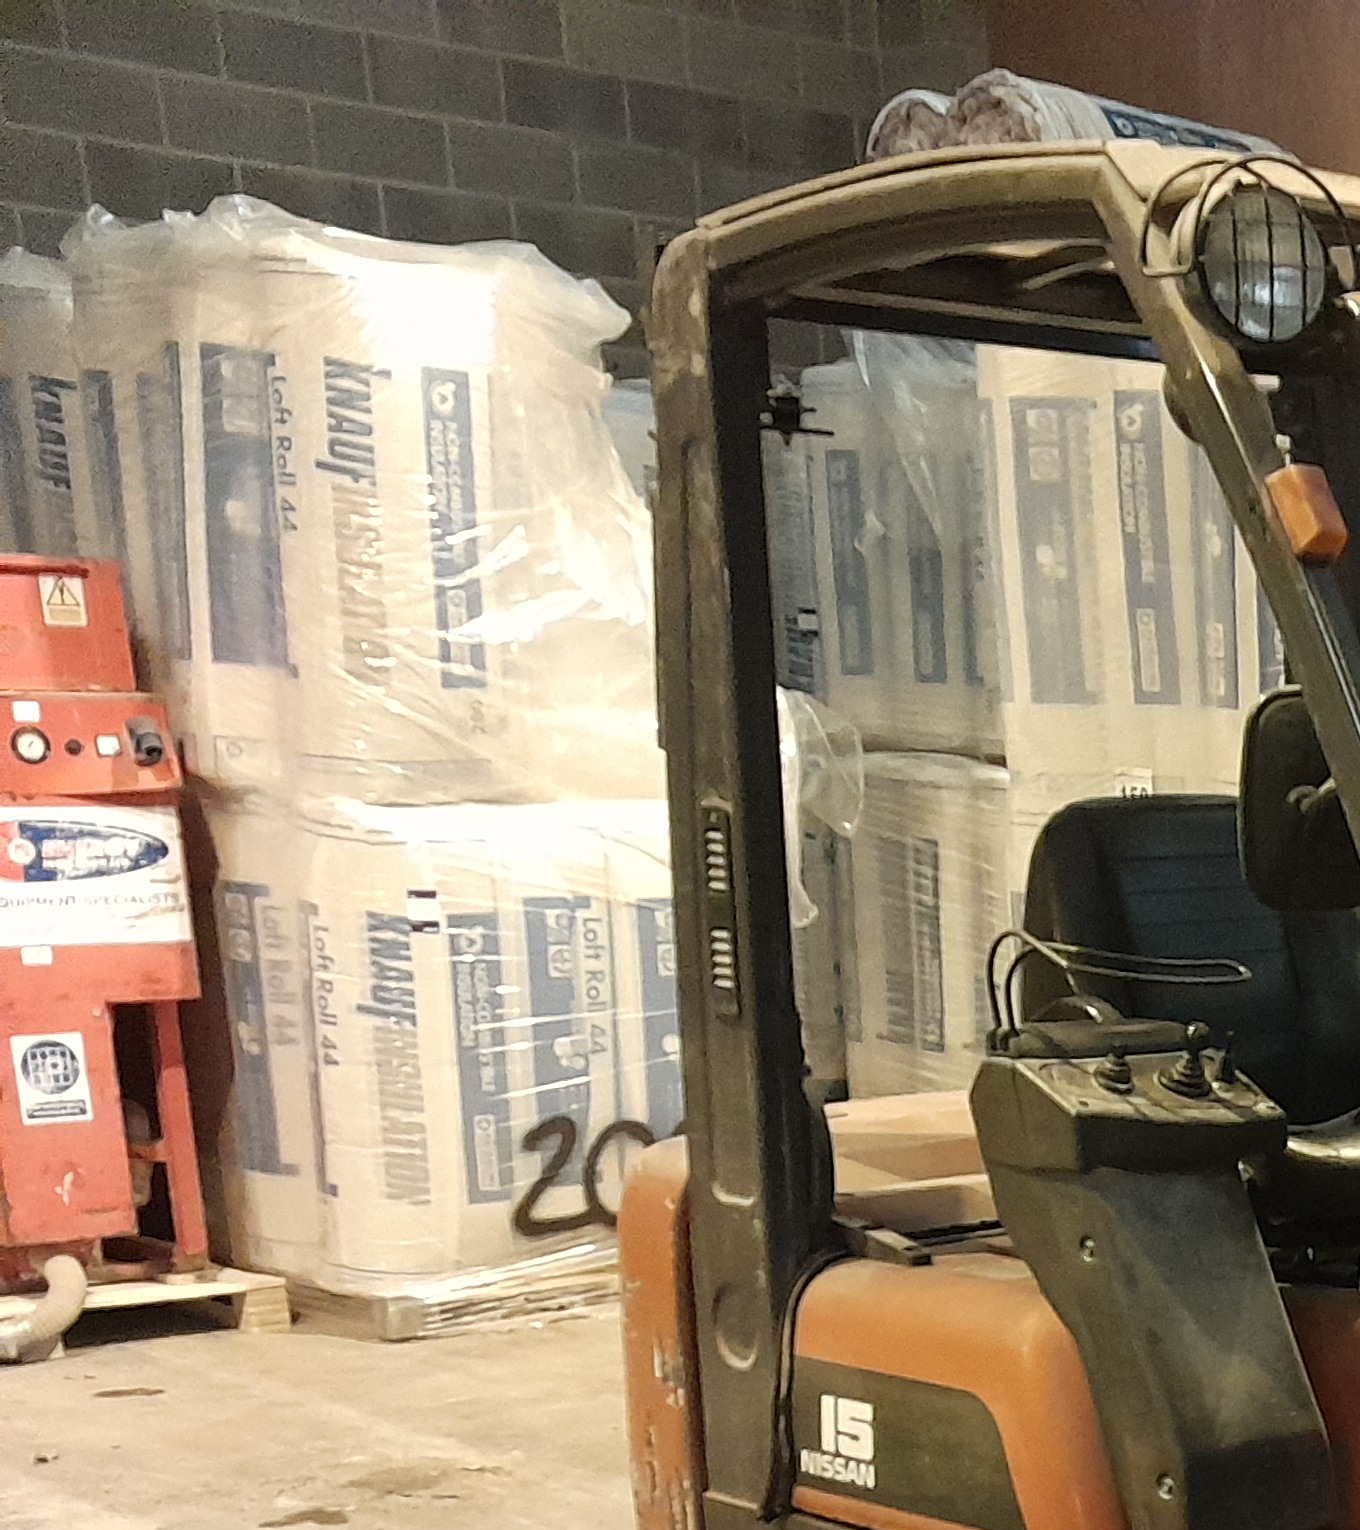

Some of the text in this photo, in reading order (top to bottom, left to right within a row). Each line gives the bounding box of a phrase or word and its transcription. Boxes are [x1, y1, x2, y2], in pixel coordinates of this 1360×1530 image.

[271, 374, 298, 533] Loft Roll 44
[316, 355, 391, 487] KNAUF
[312, 924, 340, 1067] Loft Roll 44
[357, 910, 418, 1029] KNAUF
[582, 917, 608, 1055] Loft Roll 44
[514, 1116, 656, 1236] 20
[801, 1448, 876, 1490] NISSAN
[820, 1394, 875, 1461] 15
